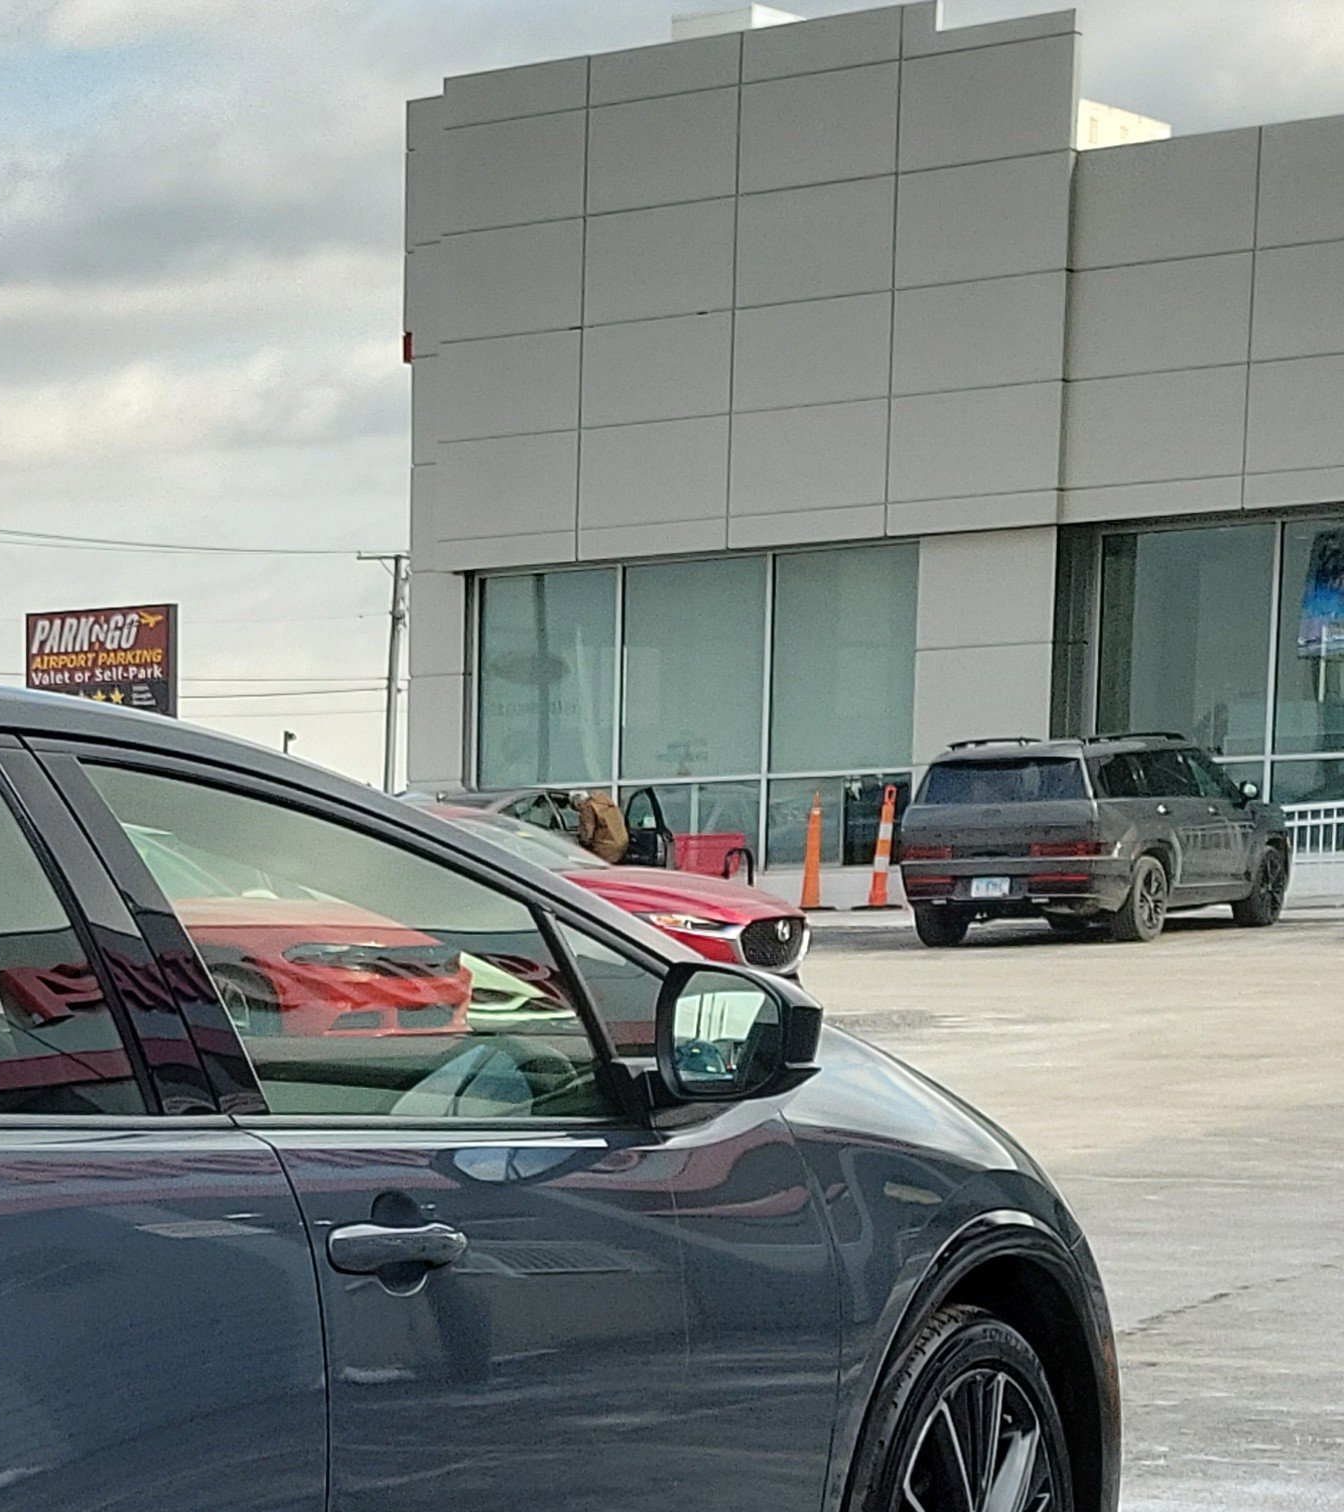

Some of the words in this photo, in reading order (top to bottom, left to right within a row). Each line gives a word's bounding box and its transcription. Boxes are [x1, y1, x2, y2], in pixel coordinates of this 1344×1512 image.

[31, 616, 96, 654] PARK
[105, 613, 140, 650] GO
[32, 652, 95, 670] AIRPORT
[97, 648, 163, 667] PARKING
[32, 669, 70, 686] Valet
[74, 671, 90, 683] or
